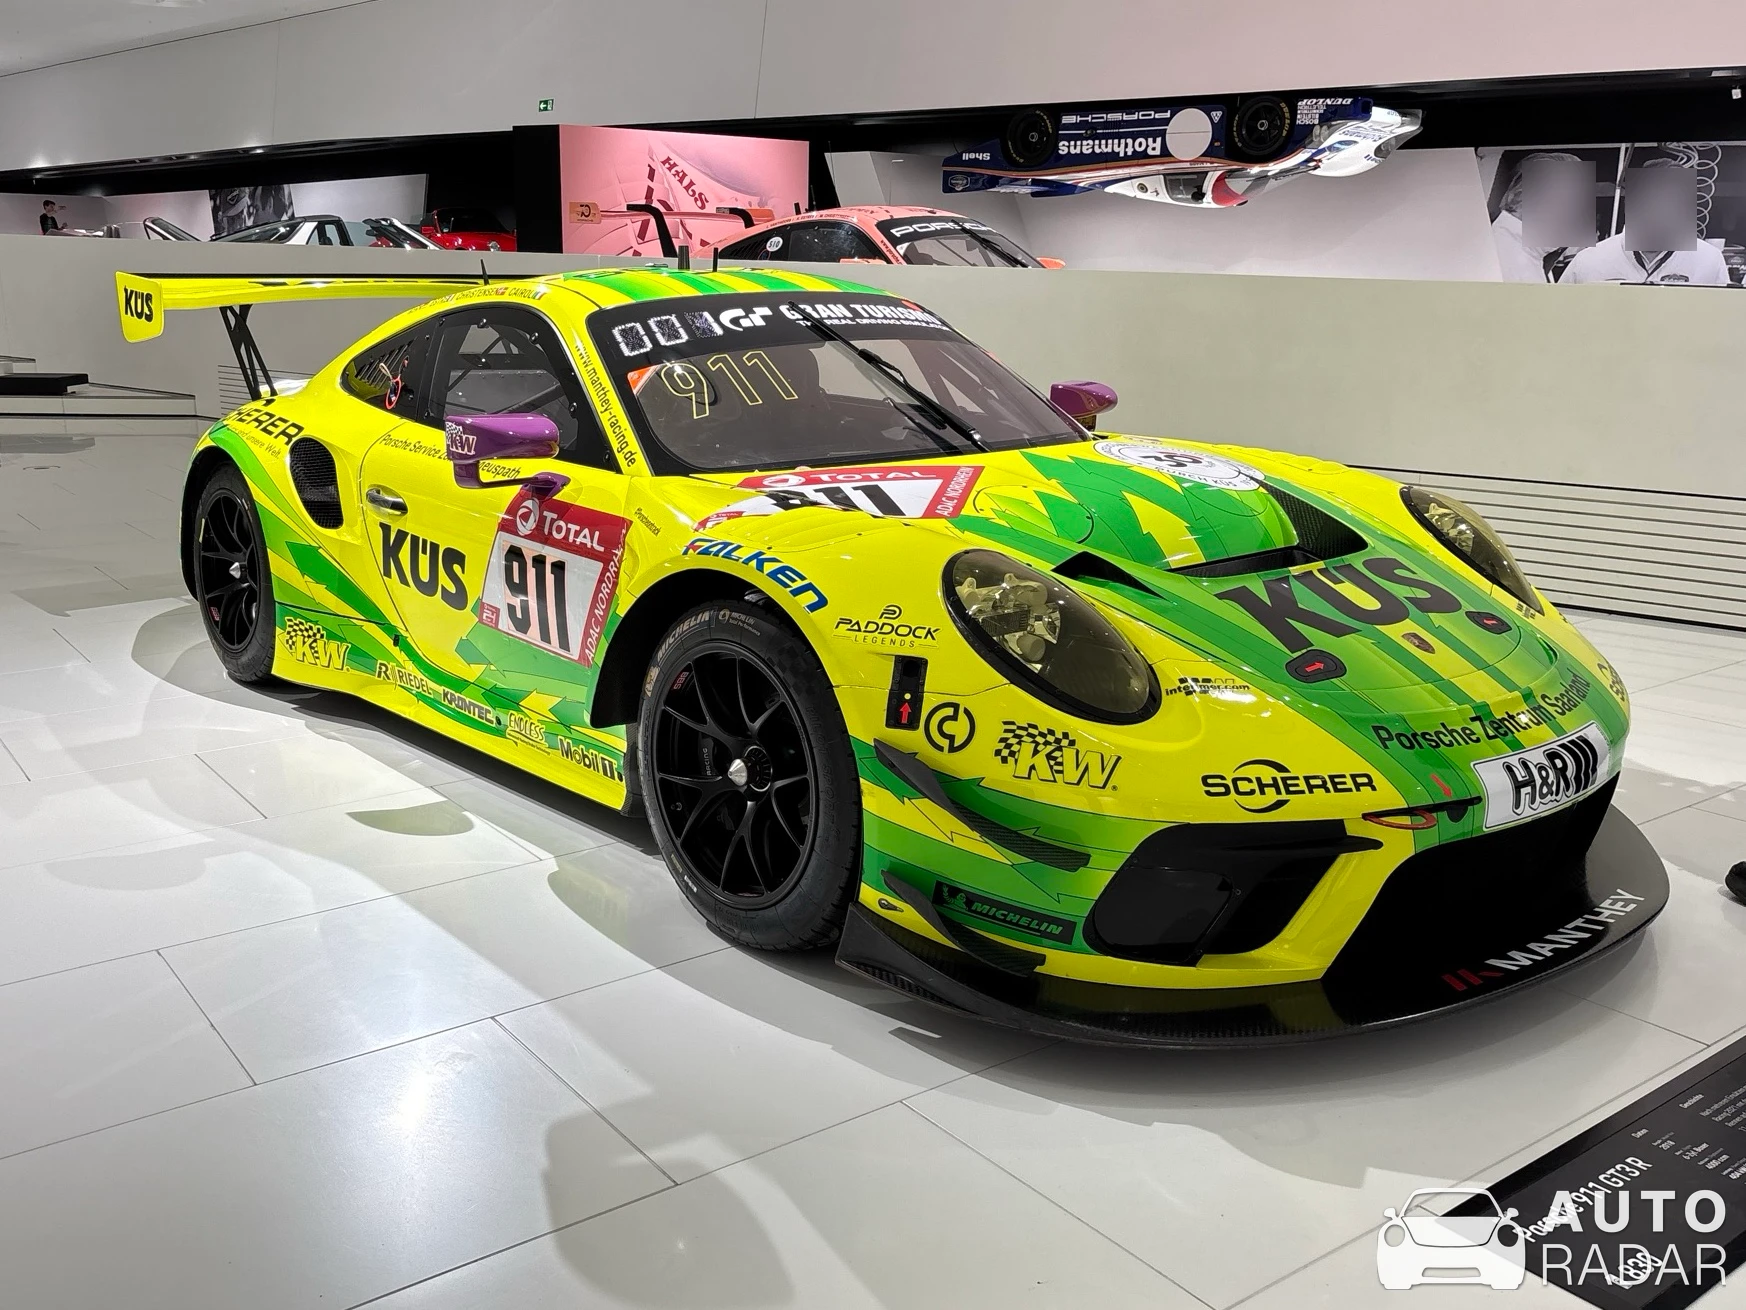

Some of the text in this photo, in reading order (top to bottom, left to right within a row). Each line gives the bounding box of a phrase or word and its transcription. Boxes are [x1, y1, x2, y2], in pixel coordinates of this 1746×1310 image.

[1061, 110, 1171, 124] PORSCHE
[1297, 97, 1353, 106] DUNLOP
[962, 152, 991, 161] Shell
[1058, 136, 1162, 157] Rothmans
[660, 155, 710, 211] HALS
[123, 284, 155, 323] KÜS
[778, 303, 854, 320] GRAN
[574, 340, 638, 468] www.manthey-racing.de
[660, 350, 799, 419] 911
[379, 433, 412, 451] Porsche
[408, 440, 441, 458] Service
[449, 434, 477, 455] KW
[810, 471, 937, 481] TOTAL
[934, 496, 957, 517] ADAC
[543, 510, 606, 552] TOTAL
[378, 521, 469, 611] KÜS
[681, 537, 830, 614] FALKEN
[504, 544, 571, 653] 911
[1217, 557, 1463, 654] KÜS
[584, 618, 601, 664] ADAC
[656, 610, 712, 663] MICHELIN
[834, 617, 942, 641] PADDOCK
[853, 635, 917, 648] LEGENDS
[294, 634, 351, 673] KW
[397, 668, 432, 696] RIEDEL
[508, 712, 545, 741] ENDLESS
[1371, 667, 1592, 751] Porsche Zentrum Saarland
[558, 737, 600, 774] Mobil
[1012, 740, 1122, 790] KW
[1201, 771, 1377, 798] SCHERER
[1502, 746, 1580, 816] H&R
[970, 901, 1064, 936] MICHELIN
[1483, 888, 1646, 971] MANTHEY
[1569, 1178, 1605, 1208] 911
[1601, 1162, 1642, 1189] GT3
[1624, 1156, 1654, 1171] R
